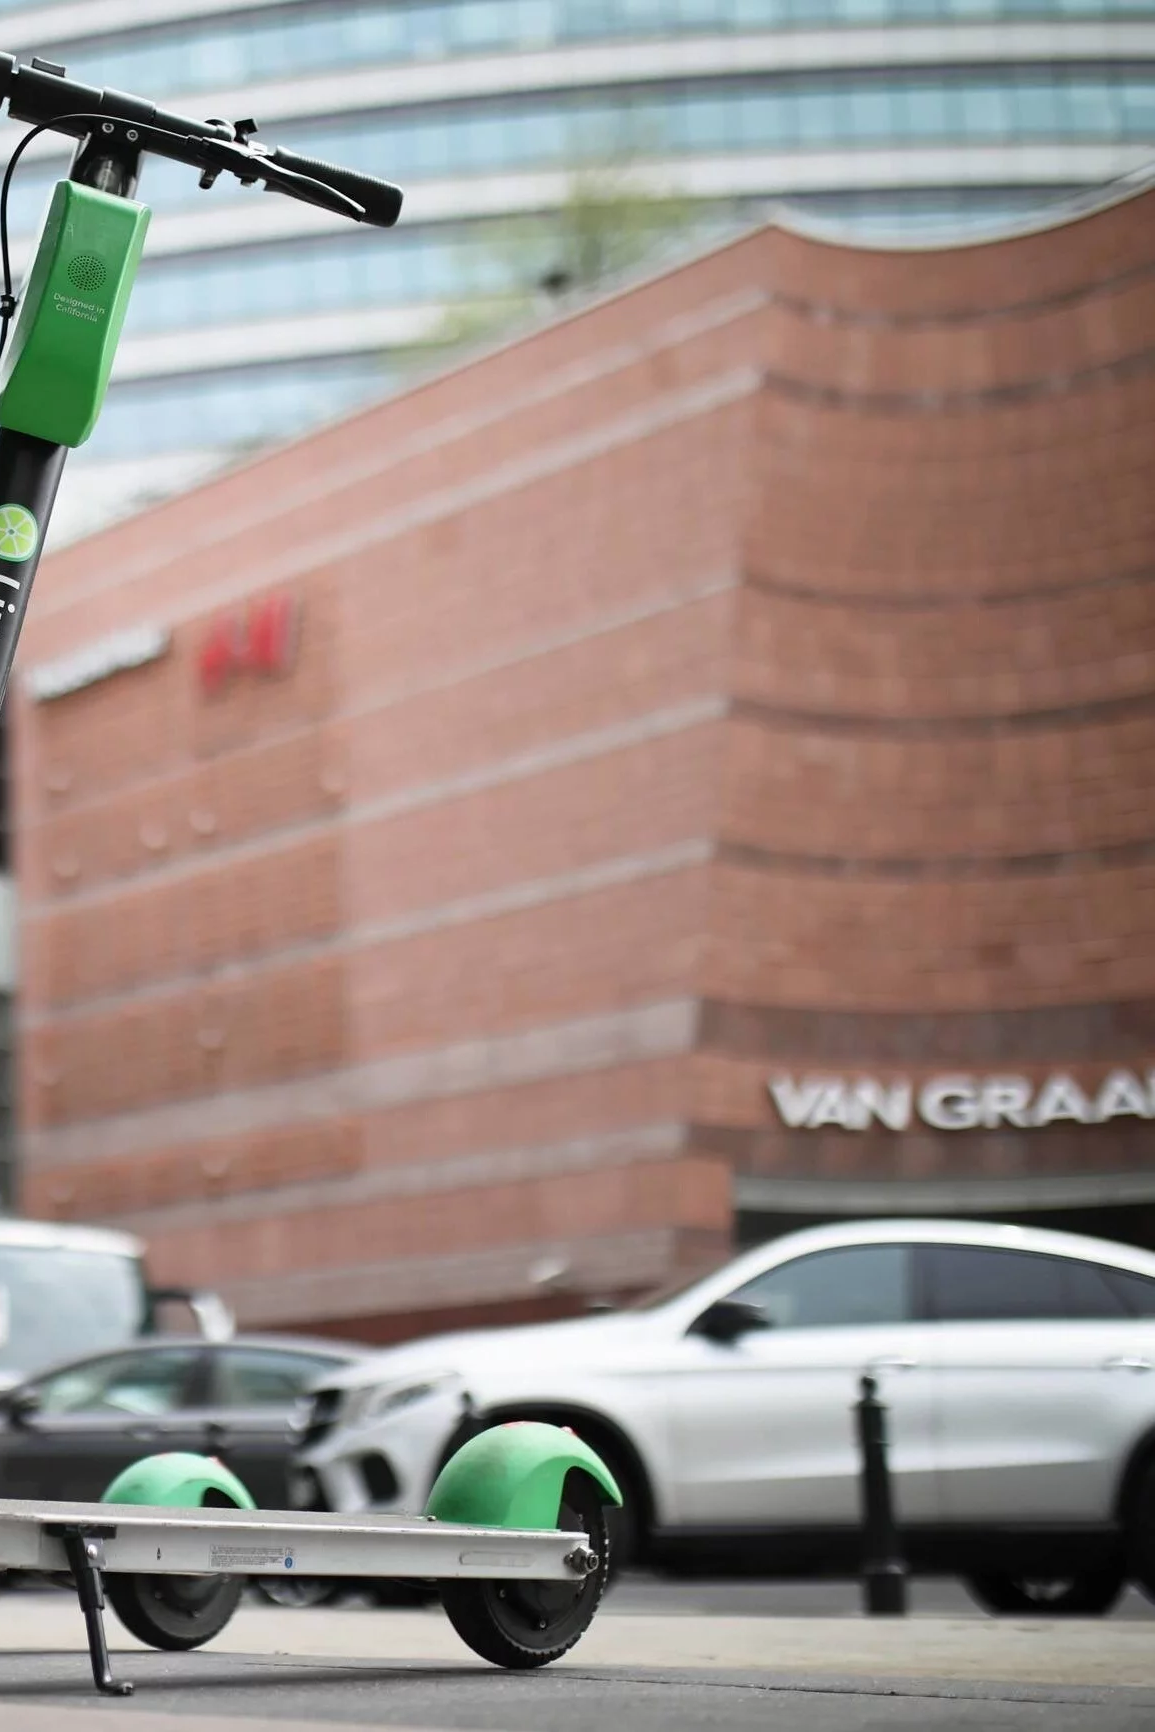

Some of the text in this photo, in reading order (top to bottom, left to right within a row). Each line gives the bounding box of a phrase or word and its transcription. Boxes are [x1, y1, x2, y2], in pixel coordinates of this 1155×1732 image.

[54, 292, 105, 314] Designed in
[55, 303, 97, 322] California
[769, 1071, 913, 1131] VAN
